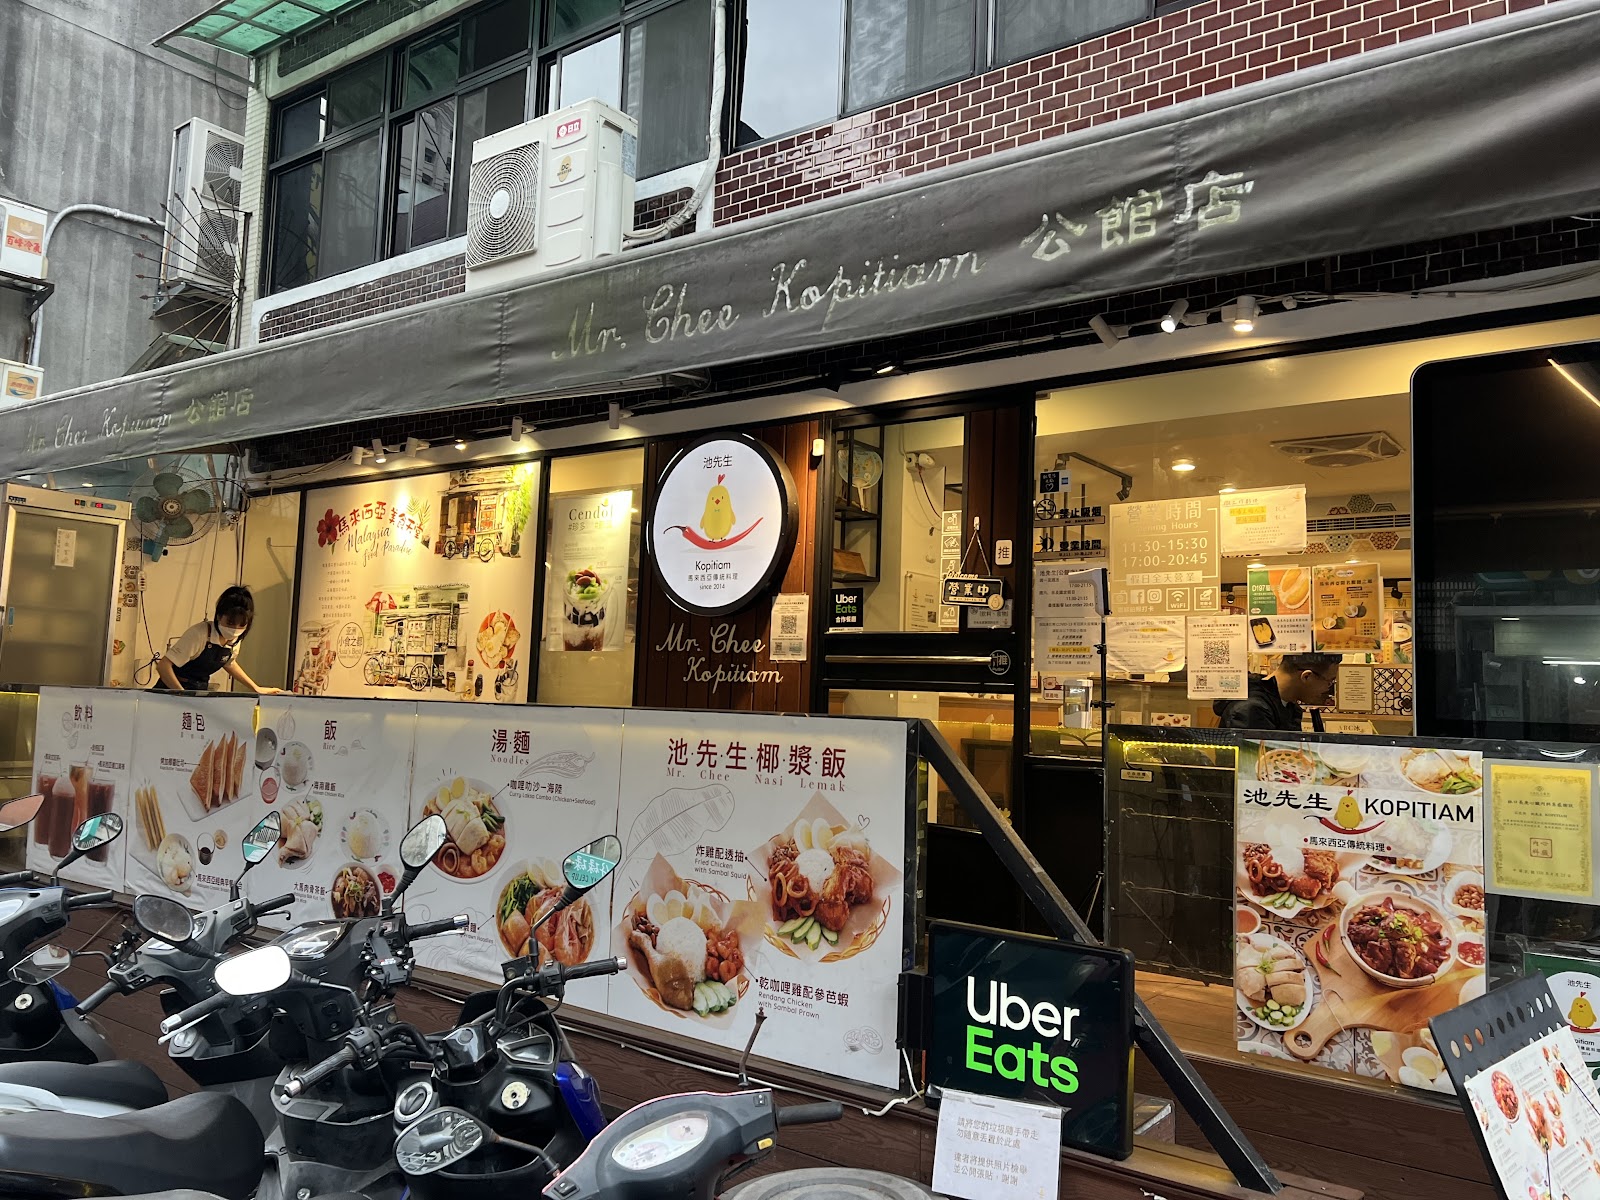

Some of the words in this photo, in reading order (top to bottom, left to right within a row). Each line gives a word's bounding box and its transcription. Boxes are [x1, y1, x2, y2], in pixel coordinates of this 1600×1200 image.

[568, 122, 580, 133] 日立
[551, 301, 627, 360] Mr.
[643, 283, 740, 344] Chee
[762, 249, 985, 331] Kopitiam
[1020, 170, 1254, 261] 公館店
[184, 388, 254, 425] 公館店
[703, 454, 733, 469] 池先生
[568, 506, 614, 521] Cendol
[1127, 500, 1202, 524] 營業時間
[1172, 522, 1198, 530] Hours
[344, 524, 390, 553] Malaysia
[1122, 537, 1208, 553] 11:30-15:30
[998, 546, 1010, 559] 推
[1122, 552, 1208, 568] 17:00-20:45
[695, 560, 731, 572] Kopitiam
[688, 572, 738, 582] 馬來西亞傳統料理
[948, 582, 990, 596] 營業中
[836, 594, 858, 604] Uber
[836, 604, 857, 614] Eats
[338, 636, 362, 647] 小食之都
[656, 622, 701, 652] Mr.
[709, 623, 766, 654] Chee
[683, 656, 784, 694] Kopitiam
[74, 704, 93, 722] 飲料
[324, 720, 338, 740] 飯
[322, 742, 336, 750] Rice
[490, 754, 530, 766] Noodles
[314, 780, 336, 792] 海南雞飯
[666, 767, 686, 778] Mr.
[700, 770, 730, 782] Chee
[754, 774, 784, 786] Nasi
[800, 778, 846, 792] Lemak
[1243, 788, 1333, 812] 池先生
[1364, 798, 1474, 823] KOPITIAM
[1309, 836, 1386, 852] 馬來西亞傳統料理
[696, 844, 744, 862] 炸雞配透抽
[694, 858, 710, 866] Fried
[710, 860, 734, 870] Chicken
[708, 868, 730, 876] Sambal
[730, 871, 747, 880] Squid
[294, 882, 326, 896] 大馬肉骨茶飯
[759, 976, 849, 1008] 乾咖哩雞配參芭蝦
[1568, 979, 1592, 990] 池先生
[758, 991, 786, 1004] Rendang
[787, 997, 812, 1009] Chicken
[758, 1000, 772, 1008] with
[774, 1002, 797, 1014] Sambal
[800, 1008, 820, 1020] Prawn
[966, 976, 1080, 1042] Uber
[1575, 1038, 1594, 1046] pitiam
[966, 1024, 1080, 1094] Eats
[957, 1116, 1039, 1140] 請將您的垃圾隨手帶走
[954, 1152, 1028, 1175] 違者將提供照片檢舉
